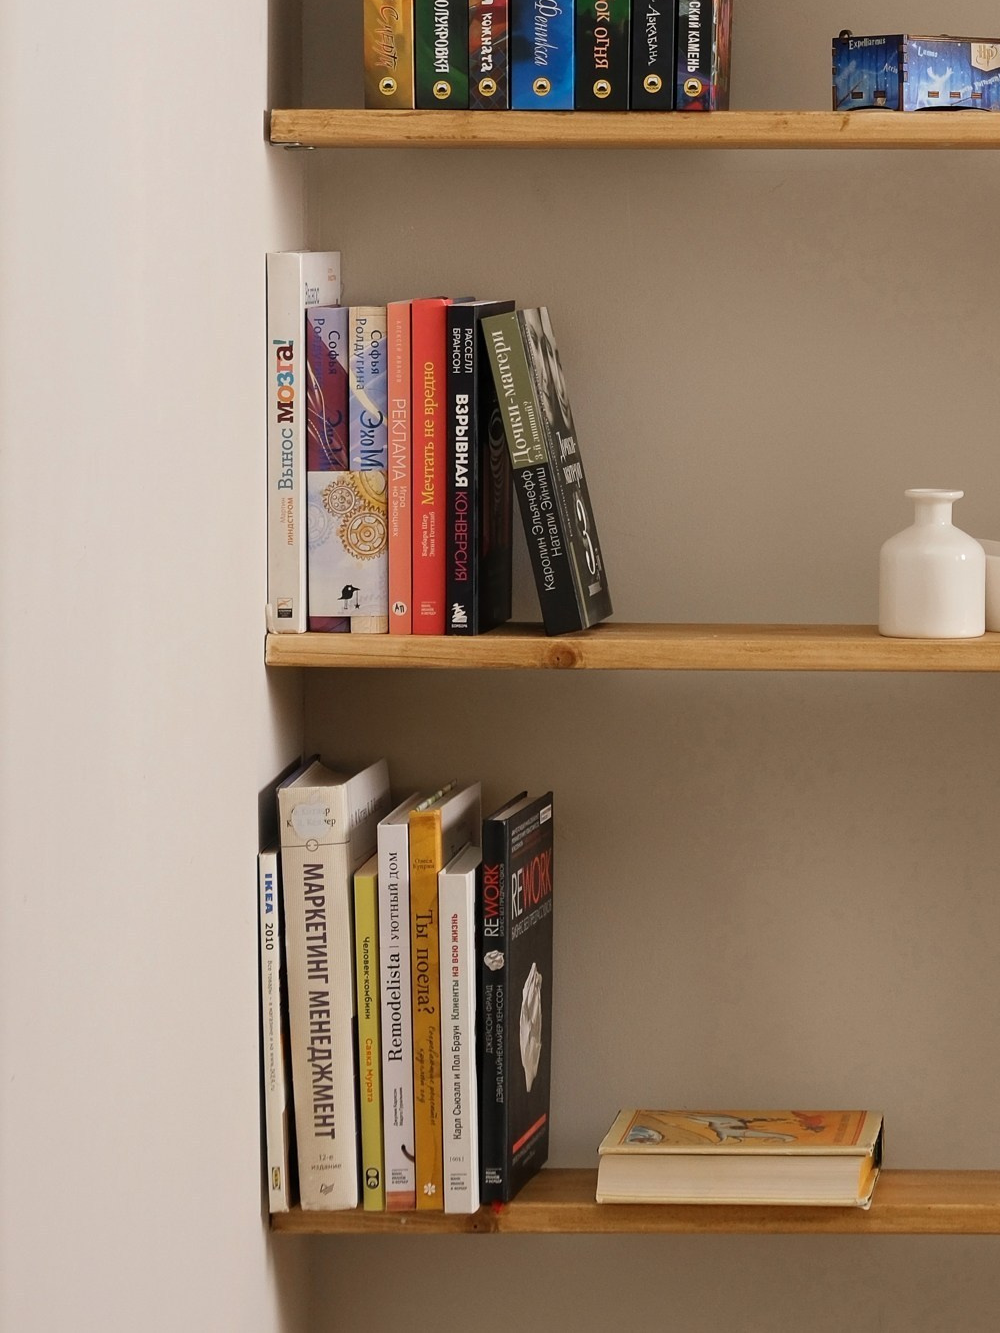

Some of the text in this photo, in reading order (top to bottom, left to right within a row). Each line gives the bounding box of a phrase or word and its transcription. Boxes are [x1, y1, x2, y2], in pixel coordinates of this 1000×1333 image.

[452, 327, 461, 373] БРАНСОН
[464, 328, 473, 373] РАССЕЛЛ
[272, 340, 295, 490] Вынос мозга!
[392, 398, 406, 480] РЕКЛАМА
[421, 362, 437, 505] Мечтать не вредно
[454, 394, 468, 580] ВЗРЫВНАЯ КОНВЕРСИЯ
[265, 872, 273, 913] IKEA
[388, 853, 400, 941] уютный дом
[416, 909, 433, 939] Ты
[484, 865, 499, 937] REWORK
[265, 922, 274, 950] 2010
[451, 914, 459, 943] жизнь
[303, 863, 336, 1139] МАРКЕТИНГ МЕНЕДЖМЕНТ
[362, 936, 372, 1019] Человек-комбини
[416, 948, 435, 1015] поела?
[450, 980, 460, 1021] Клиенты
[452, 966, 459, 977] на
[386, 953, 403, 1062] Remodelista
